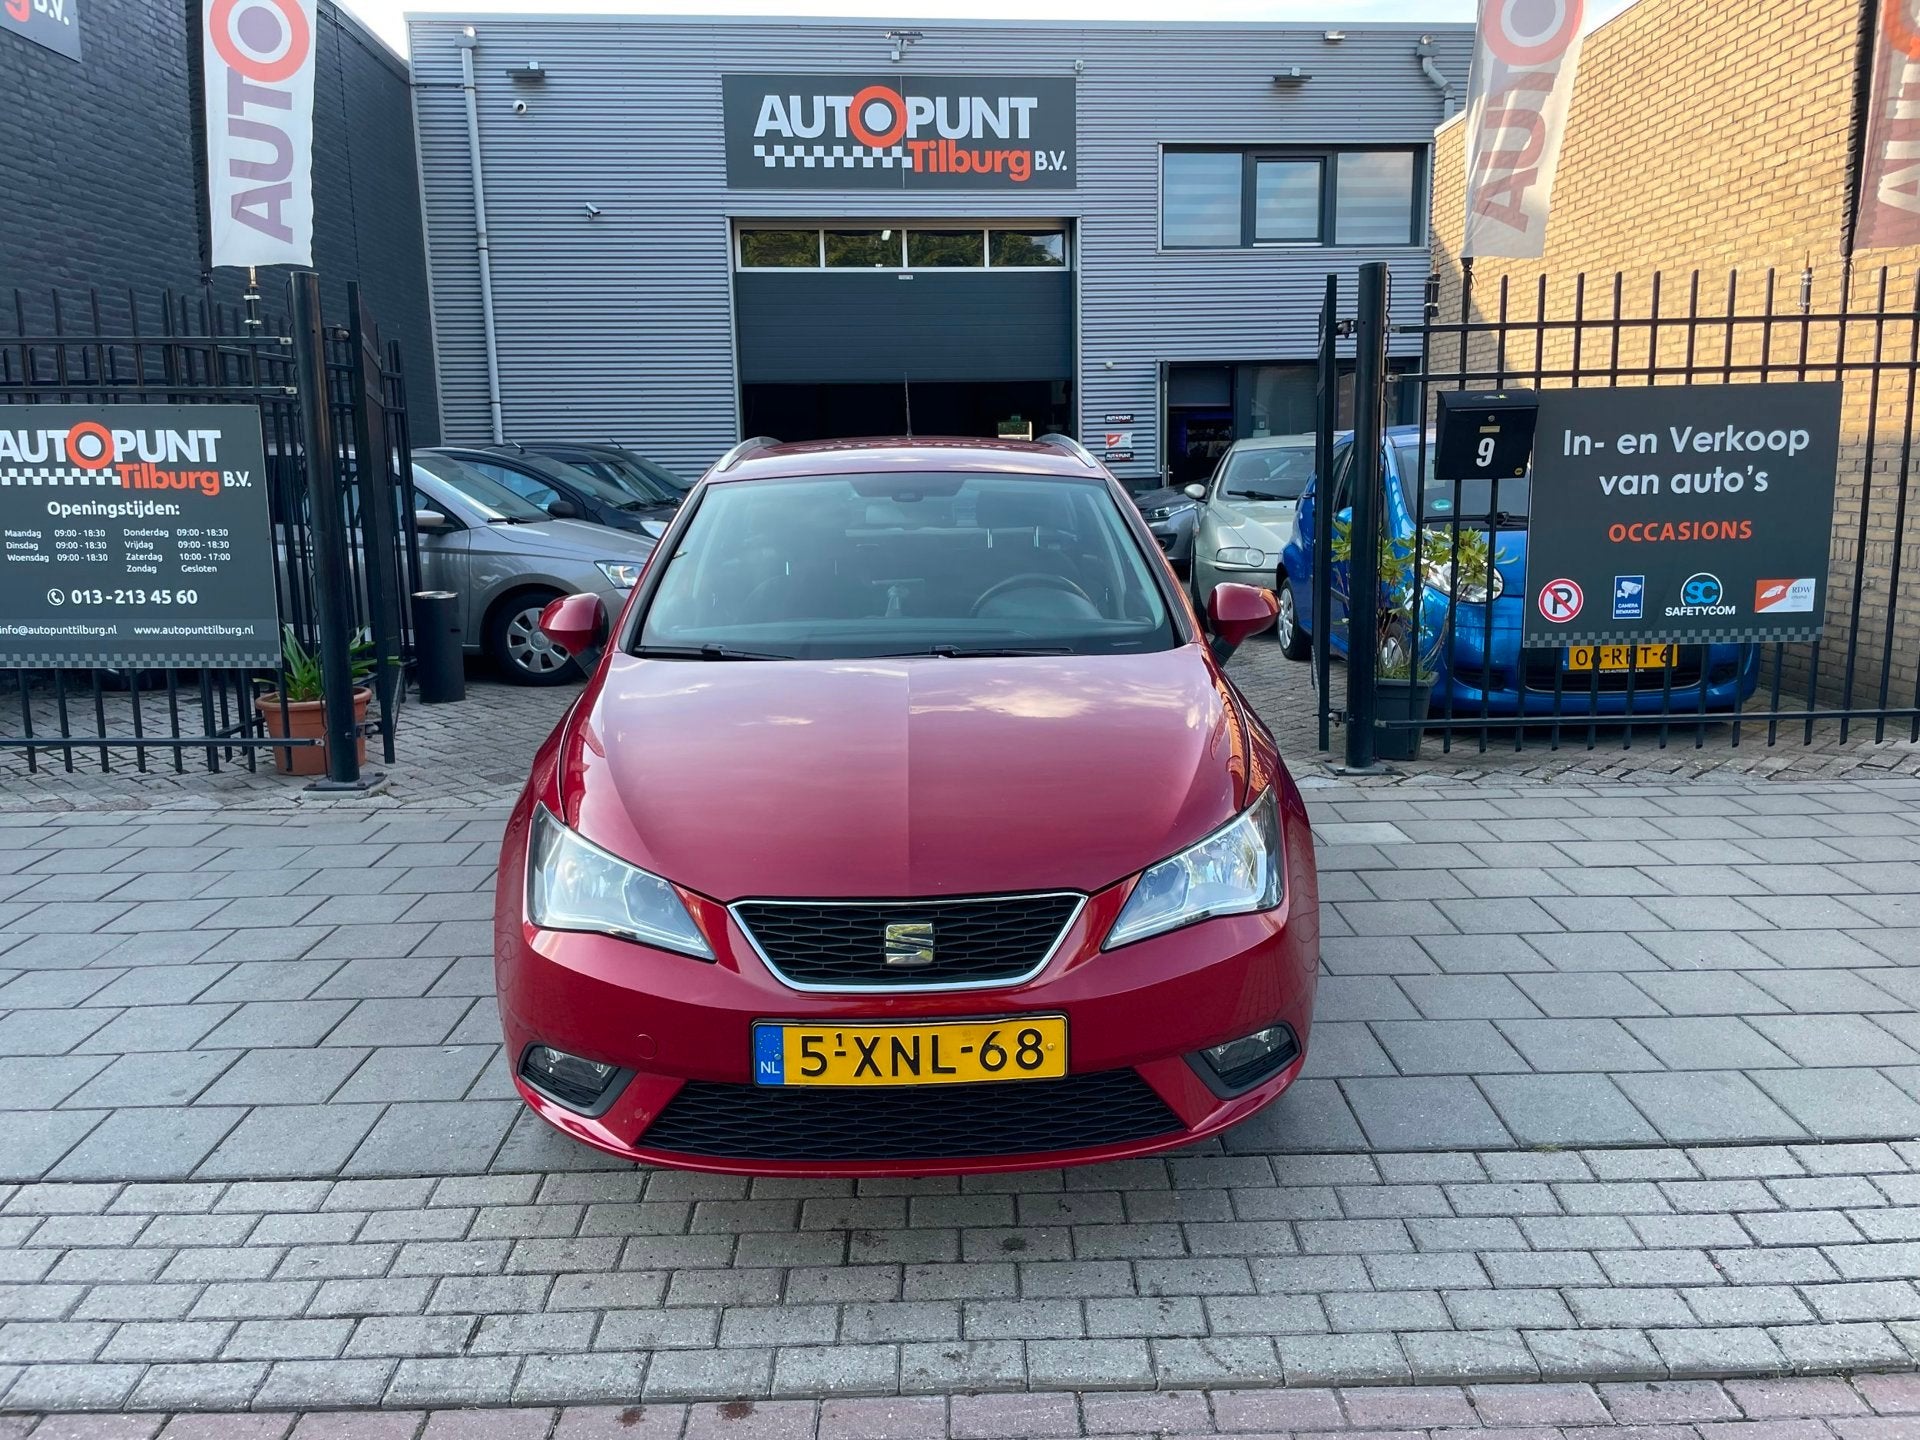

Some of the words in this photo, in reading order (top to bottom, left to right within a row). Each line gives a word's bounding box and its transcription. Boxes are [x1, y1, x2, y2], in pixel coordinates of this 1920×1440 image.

[753, 85, 1038, 148] AUTOPUNT
[908, 139, 1031, 182] Tilburg
[1034, 150, 1068, 172] B.V.
[0, 421, 222, 470] AUTOPUNT
[1563, 430, 1605, 456] In-
[1616, 433, 1658, 455] en
[1670, 425, 1810, 457] Verkoop
[1475, 437, 1496, 467] 9
[115, 463, 220, 496] Tilburg
[223, 470, 252, 488] B.V.
[1599, 473, 1660, 496] van
[1670, 465, 1769, 495] auto's
[47, 500, 180, 518] Openingstijden:
[4, 529, 42, 539] Maandag
[54, 529, 77, 537] 09:00
[83, 529, 106, 537] 18:30
[123, 528, 169, 538] Donderdag
[176, 529, 200, 537] 09:00
[206, 529, 229, 537] 18:30
[1608, 520, 1753, 543] OCCASIONS
[6, 541, 39, 551] Dinsdag
[55, 541, 79, 550] 09:00
[84, 541, 107, 549] 18:30
[124, 541, 154, 550] Vrijdag
[177, 541, 201, 549] 09:00
[207, 541, 230, 549] 18:30
[7, 554, 50, 563] Woensdag
[57, 554, 80, 562] 09:00
[86, 553, 108, 562] 18:30
[125, 553, 163, 562] Zaterdag
[179, 553, 202, 561] 10:00
[208, 553, 231, 561] 17:00
[126, 564, 158, 574] Zondag
[181, 564, 218, 573] Gesloten
[150, 589, 172, 604] 45
[176, 589, 198, 604] 60
[1685, 581, 1718, 604] SC
[1791, 586, 1812, 594] RDW
[1664, 605, 1736, 617] SAFETYCOM
[0, 625, 118, 637] info@autopunttilburg.nl
[134, 625, 255, 637] www.autopunttilburg.nl
[760, 1060, 781, 1075] NL
